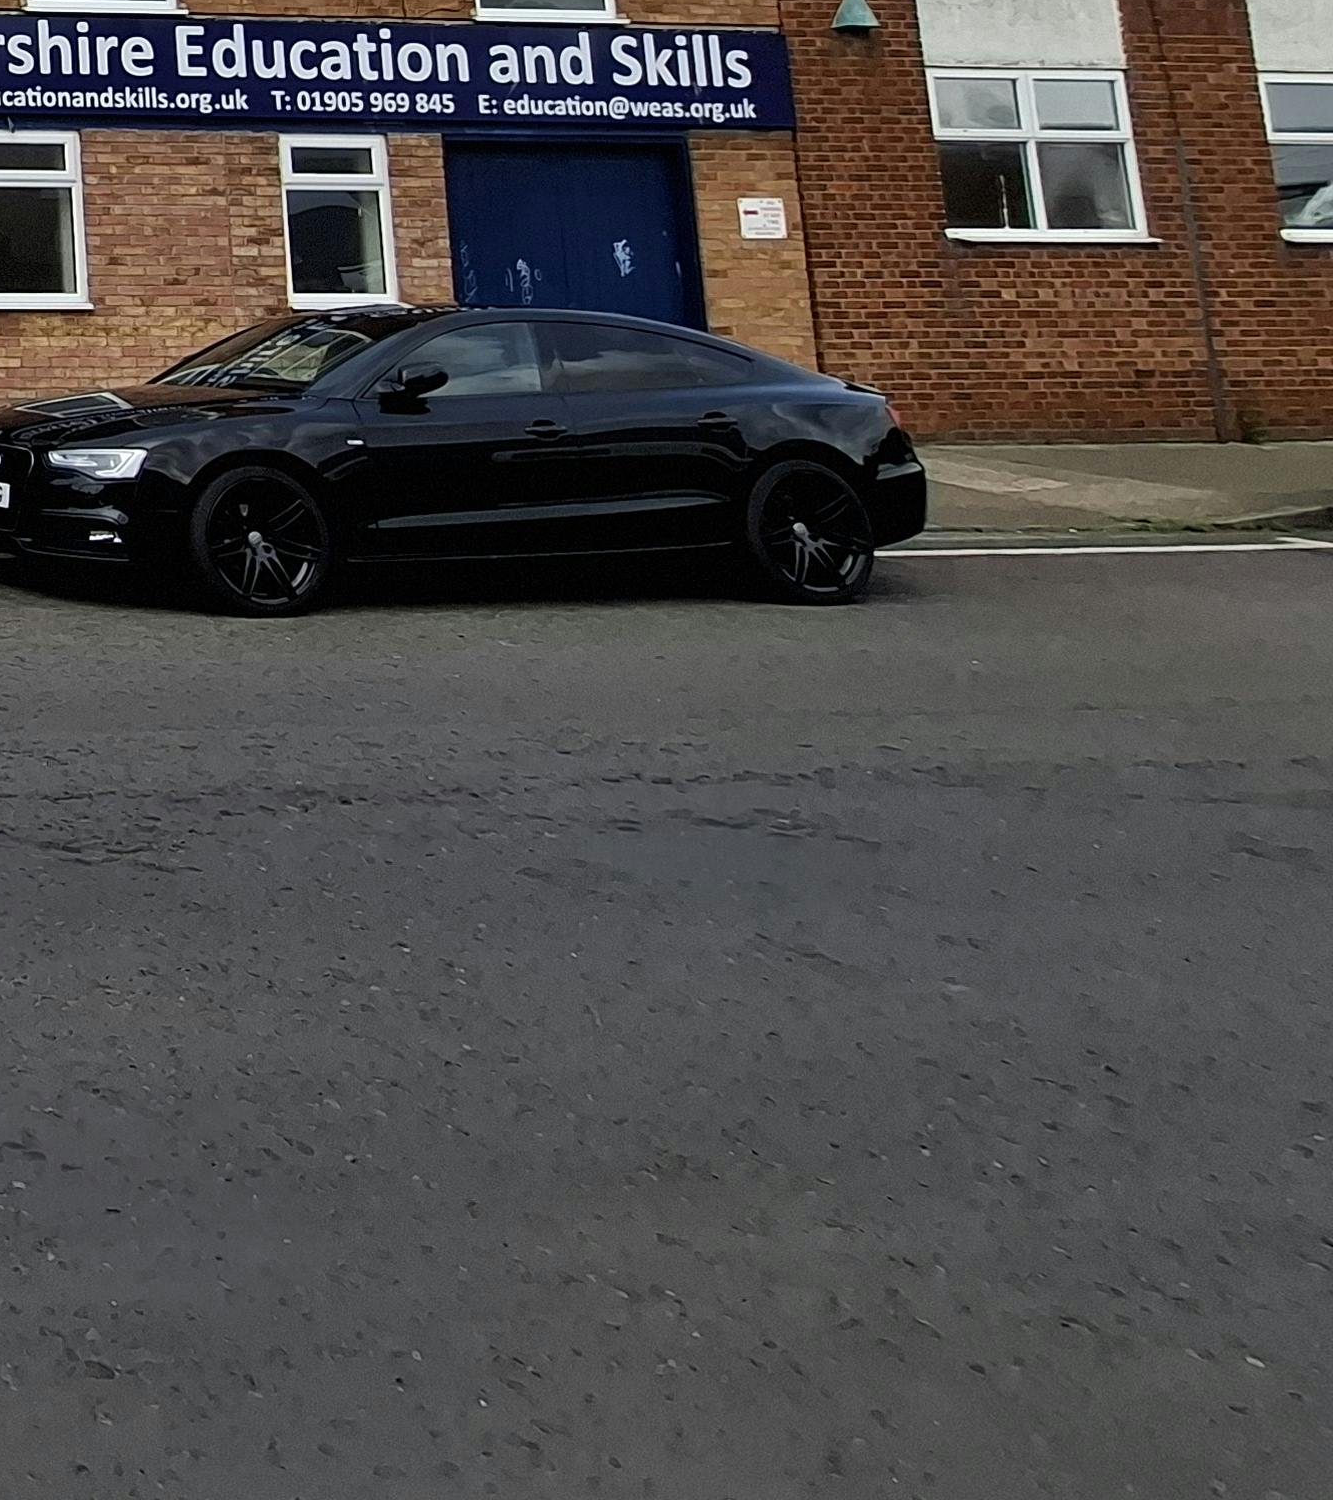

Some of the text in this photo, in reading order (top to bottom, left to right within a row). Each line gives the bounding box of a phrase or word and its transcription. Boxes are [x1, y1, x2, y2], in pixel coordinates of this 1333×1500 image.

[175, 23, 470, 83] Education
[488, 31, 594, 85] and
[610, 32, 752, 89] Skills
[270, 90, 292, 111] T:
[296, 90, 364, 113] 01905
[369, 92, 410, 113] 969
[415, 92, 455, 114] 845
[477, 94, 498, 115] E:
[503, 93, 757, 123] education@weas.org.uk
